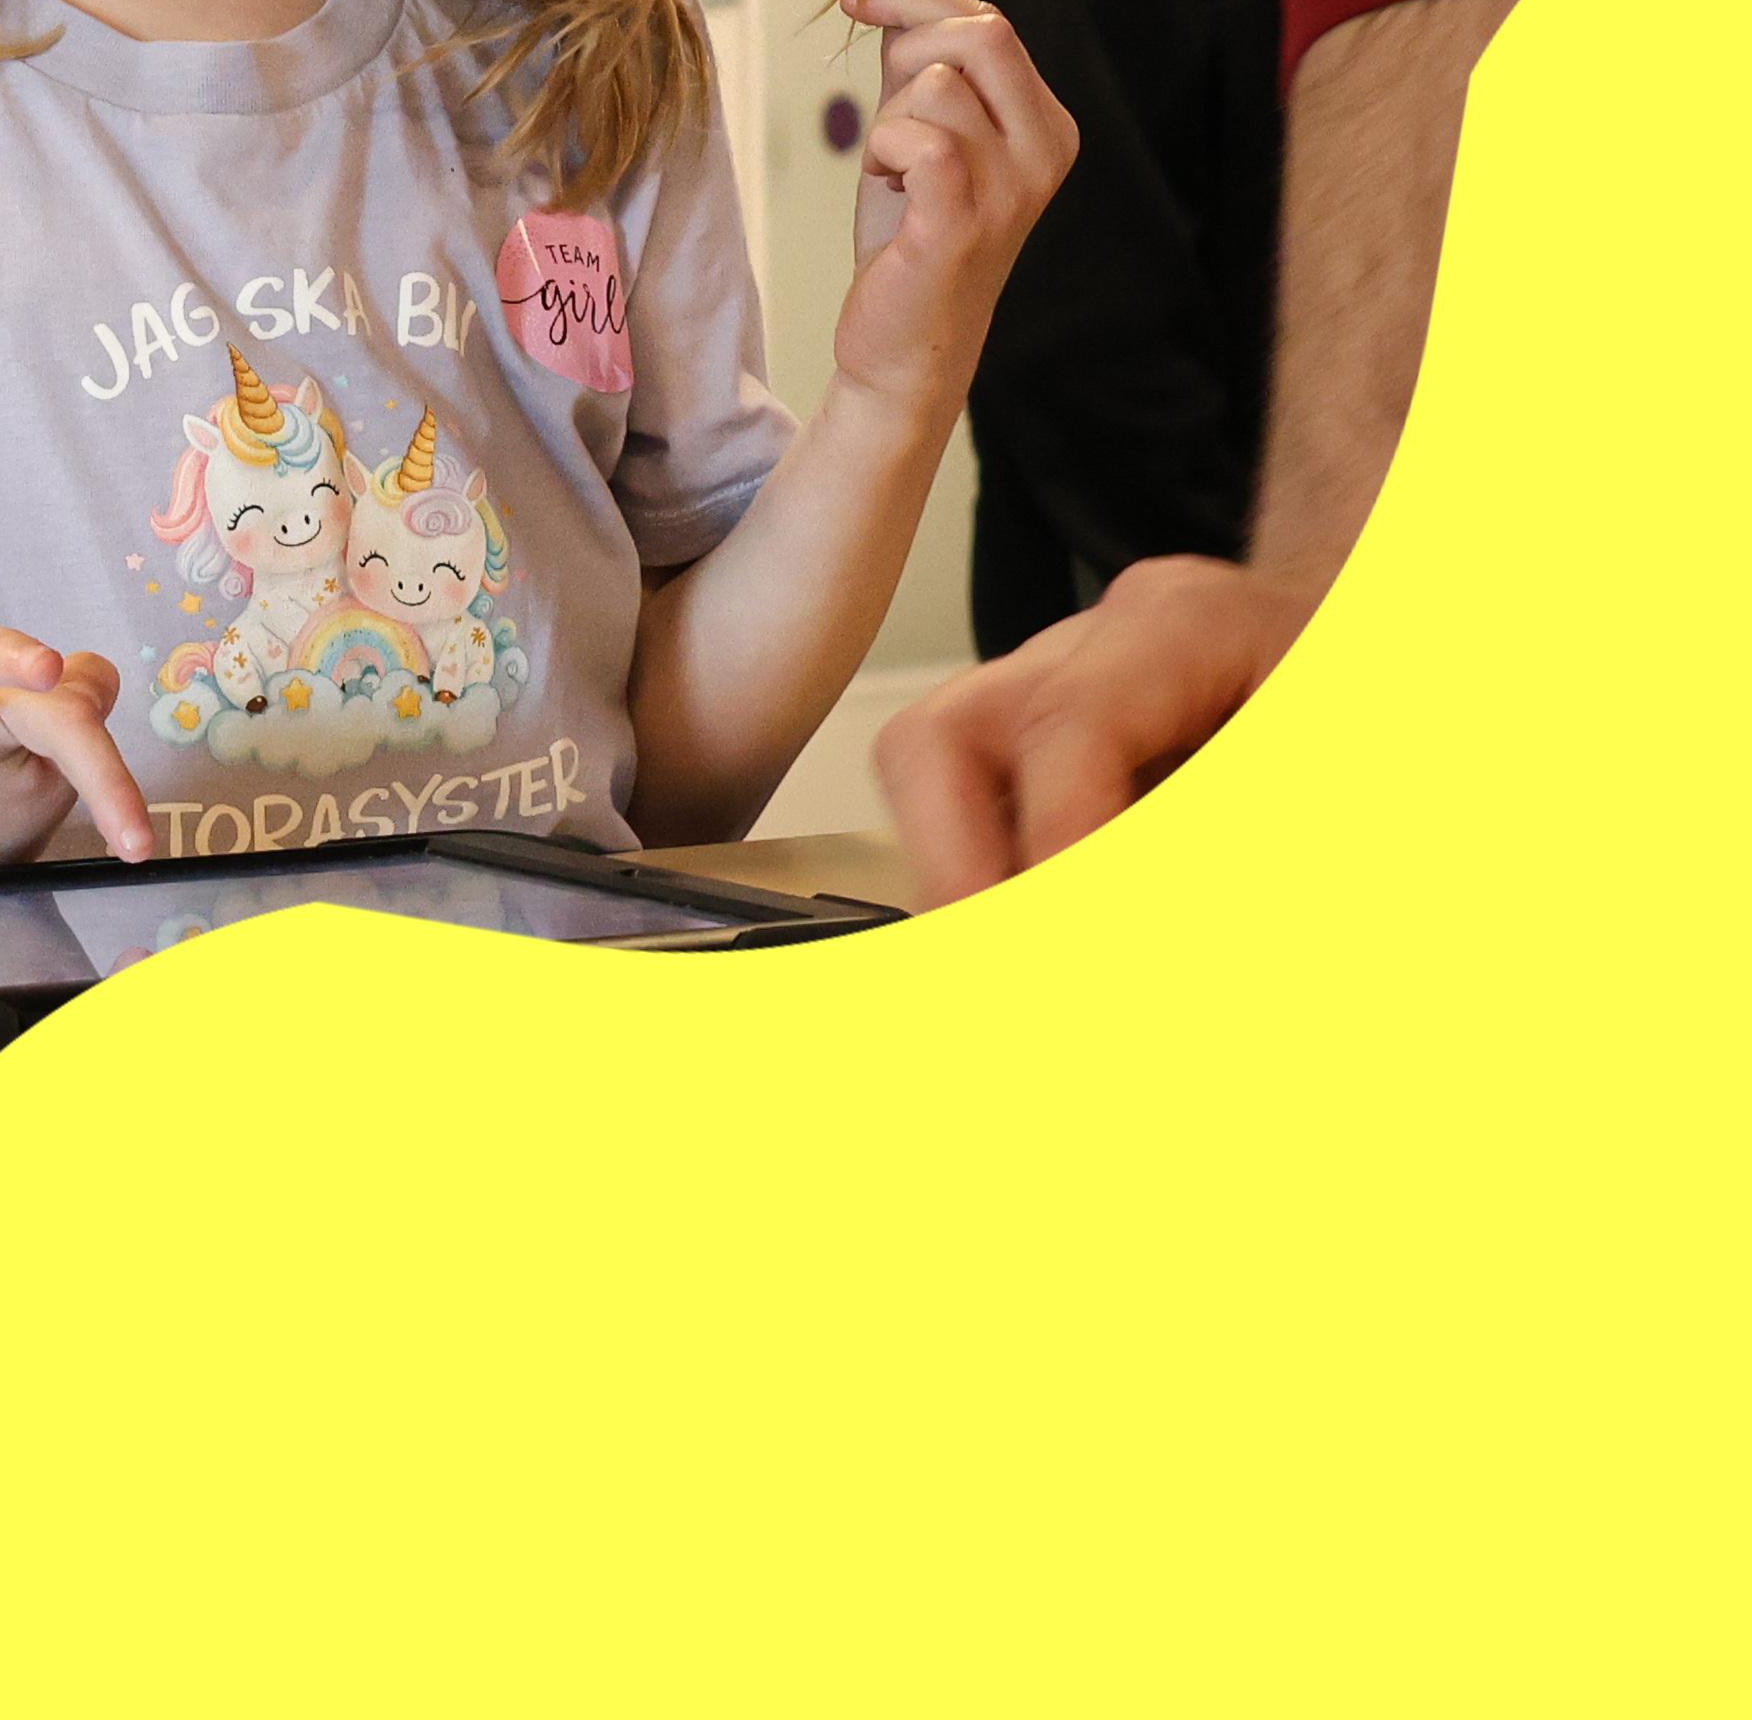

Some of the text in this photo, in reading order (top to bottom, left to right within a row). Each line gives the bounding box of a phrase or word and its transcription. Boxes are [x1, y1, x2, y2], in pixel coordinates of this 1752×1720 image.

[545, 244, 600, 273] TEAM
[81, 281, 221, 400] JAG
[235, 265, 373, 341] SKA
[501, 274, 625, 346] girl
[106, 736, 587, 858] TORASYSTER
